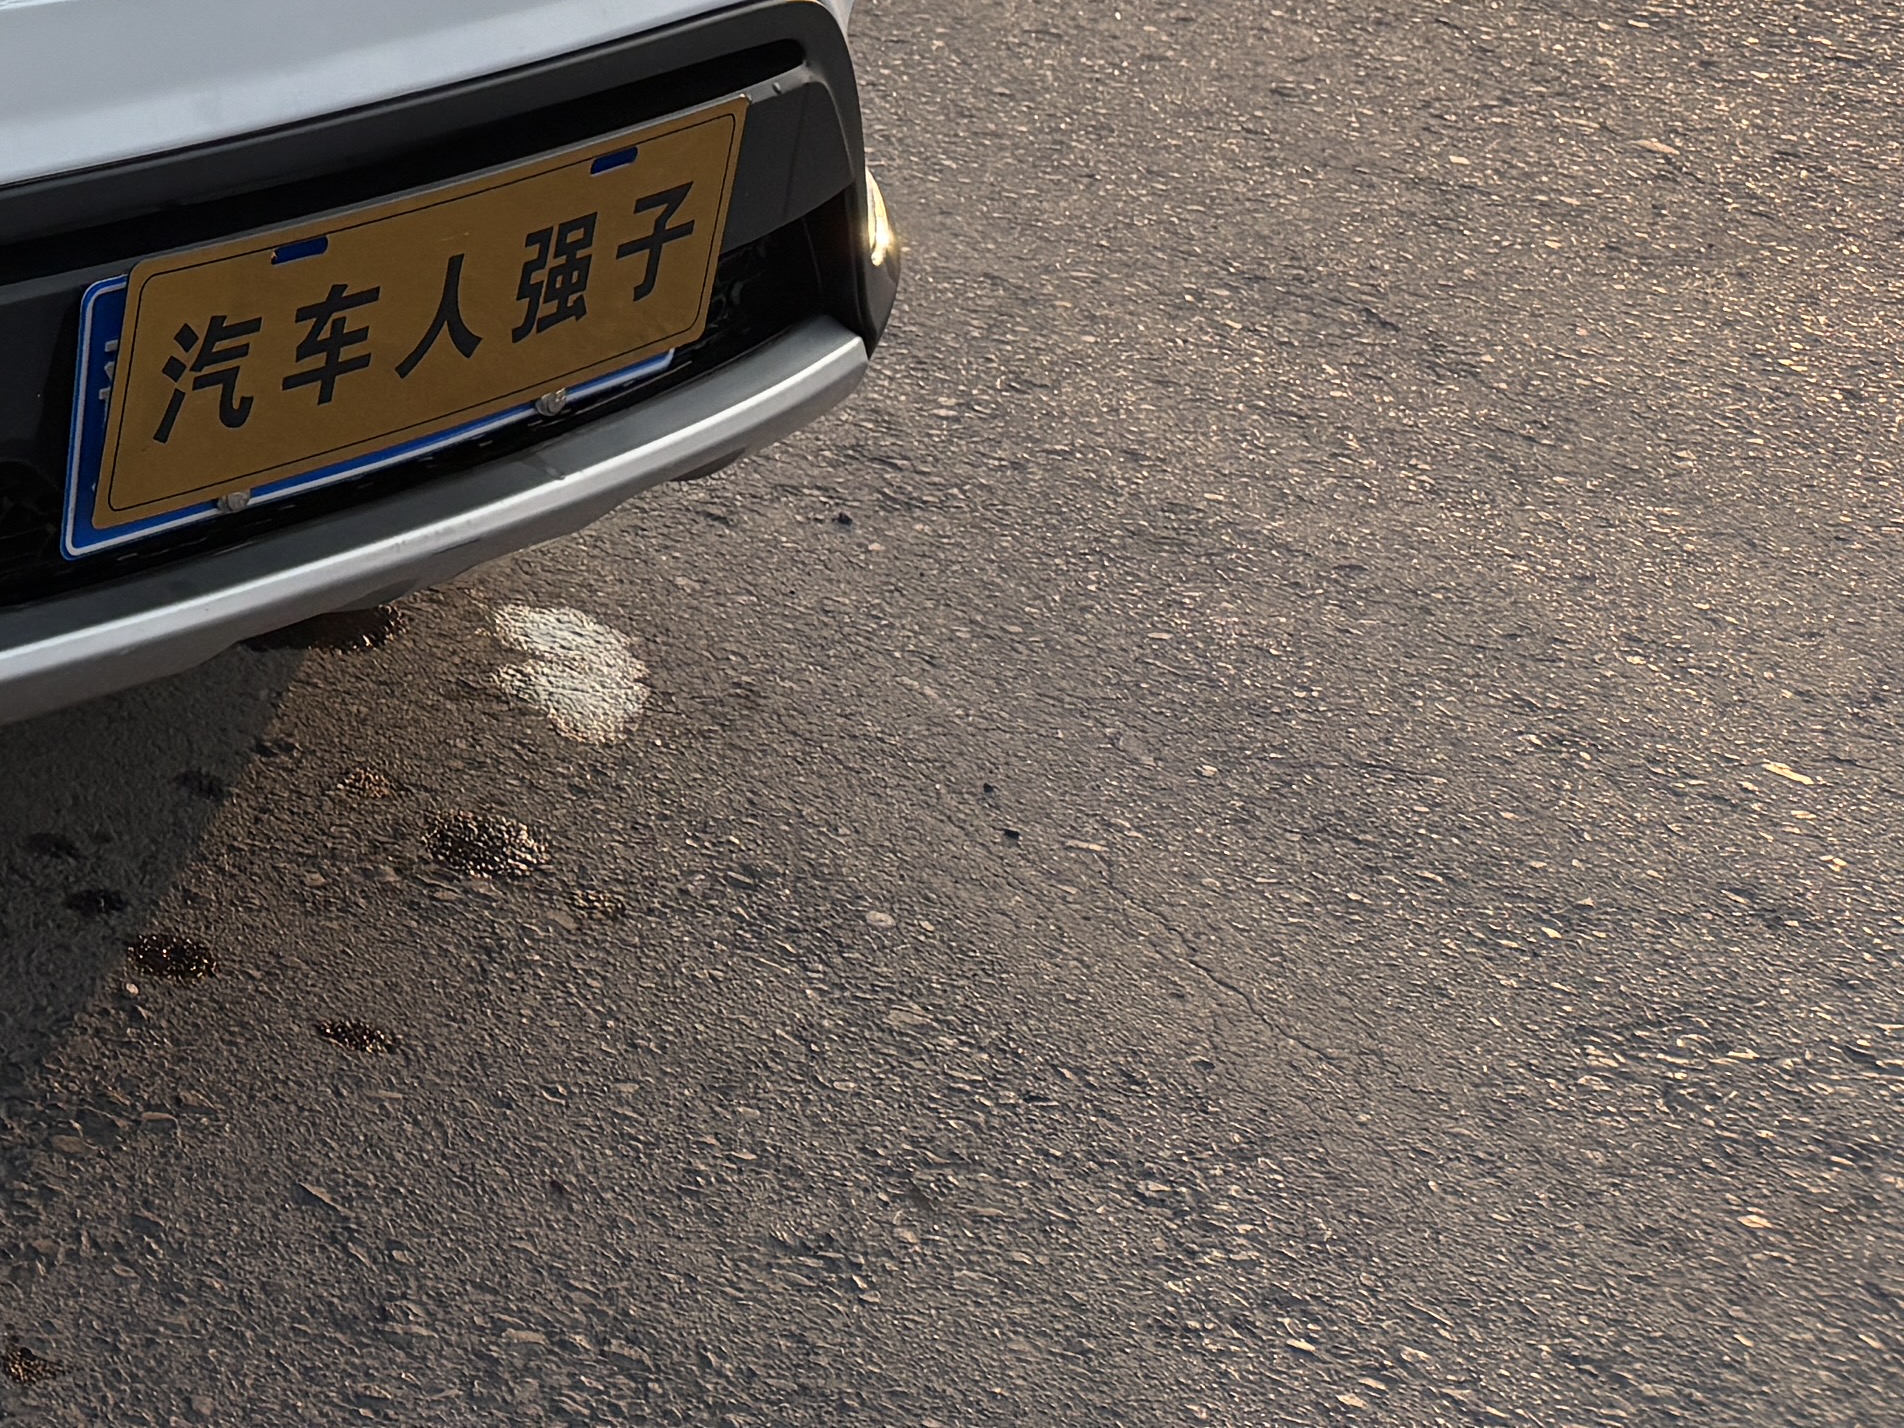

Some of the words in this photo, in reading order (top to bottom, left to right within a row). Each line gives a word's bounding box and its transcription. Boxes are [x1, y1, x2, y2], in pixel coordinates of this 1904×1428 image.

[153, 180, 696, 445] 汽车人强子
